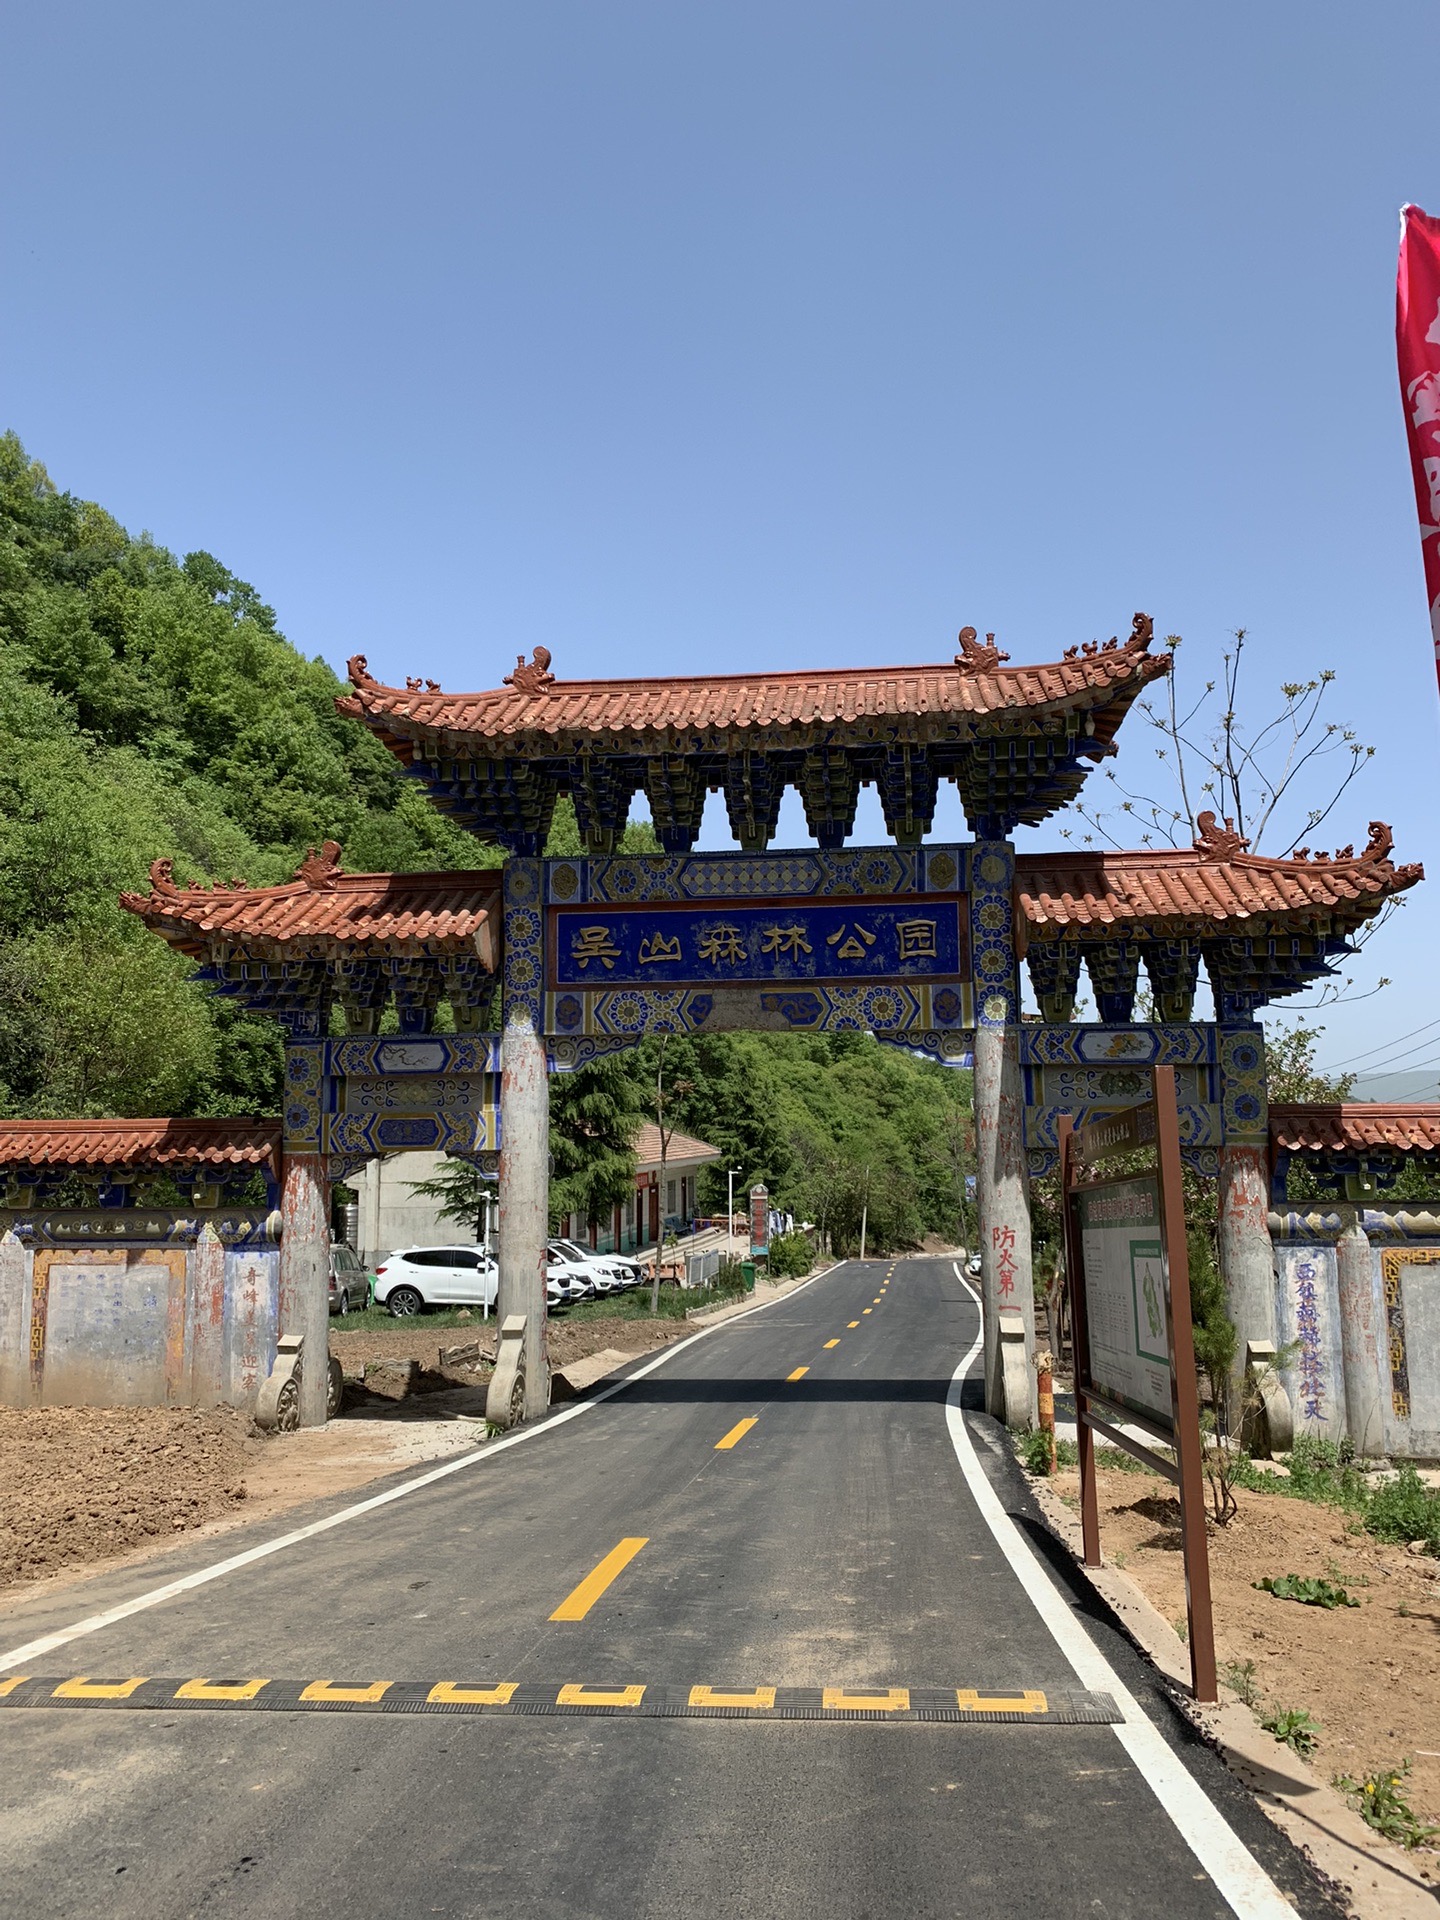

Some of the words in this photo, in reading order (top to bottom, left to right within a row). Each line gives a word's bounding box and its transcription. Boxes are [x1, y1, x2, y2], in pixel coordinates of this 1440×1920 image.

[571, 920, 937, 969] 吴山森林公园
[991, 1225, 1022, 1311] 防火第一
